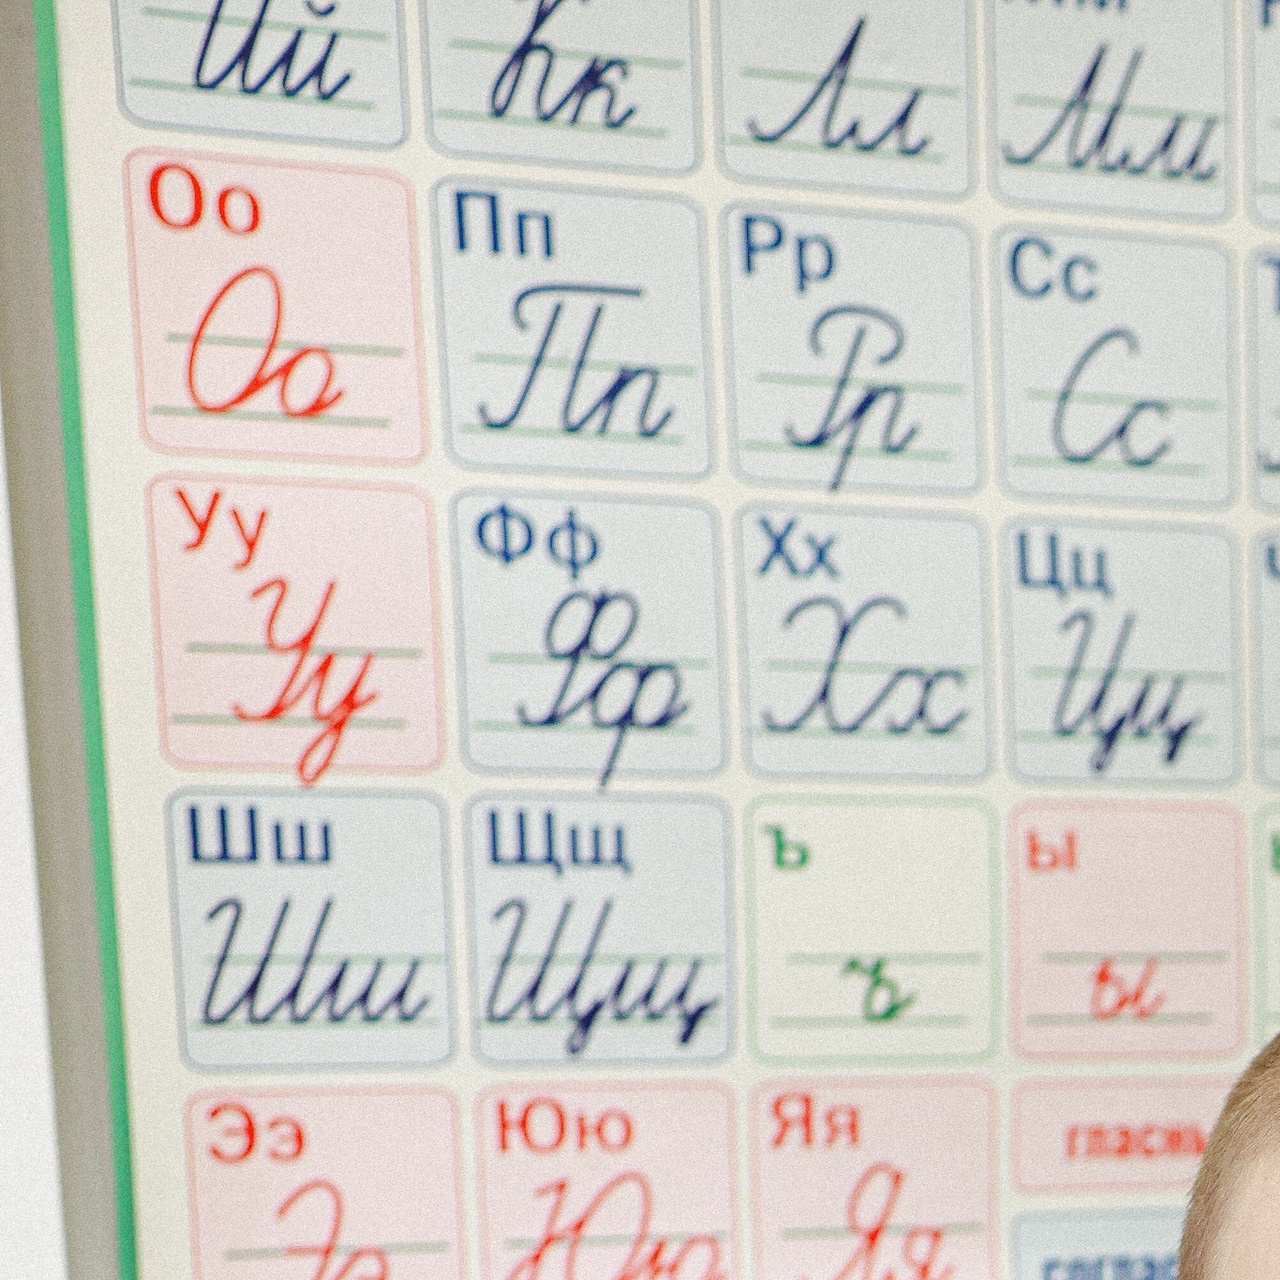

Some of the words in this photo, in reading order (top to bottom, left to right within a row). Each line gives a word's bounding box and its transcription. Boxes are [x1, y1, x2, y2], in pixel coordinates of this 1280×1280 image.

[146, 162, 263, 234] Оо
[453, 189, 555, 259] Пп
[741, 213, 837, 294] Рр
[1007, 236, 1099, 302] Сс
[174, 487, 268, 570] Уу
[474, 502, 601, 581] Фф
[759, 518, 836, 577] Хх
[1016, 531, 1112, 597] Цц
[187, 804, 332, 865] Шш
[487, 809, 631, 876] Щщ
[208, 1104, 306, 1162] Ээ
[495, 1099, 634, 1152] Юю
[771, 1092, 860, 1147] Яя
